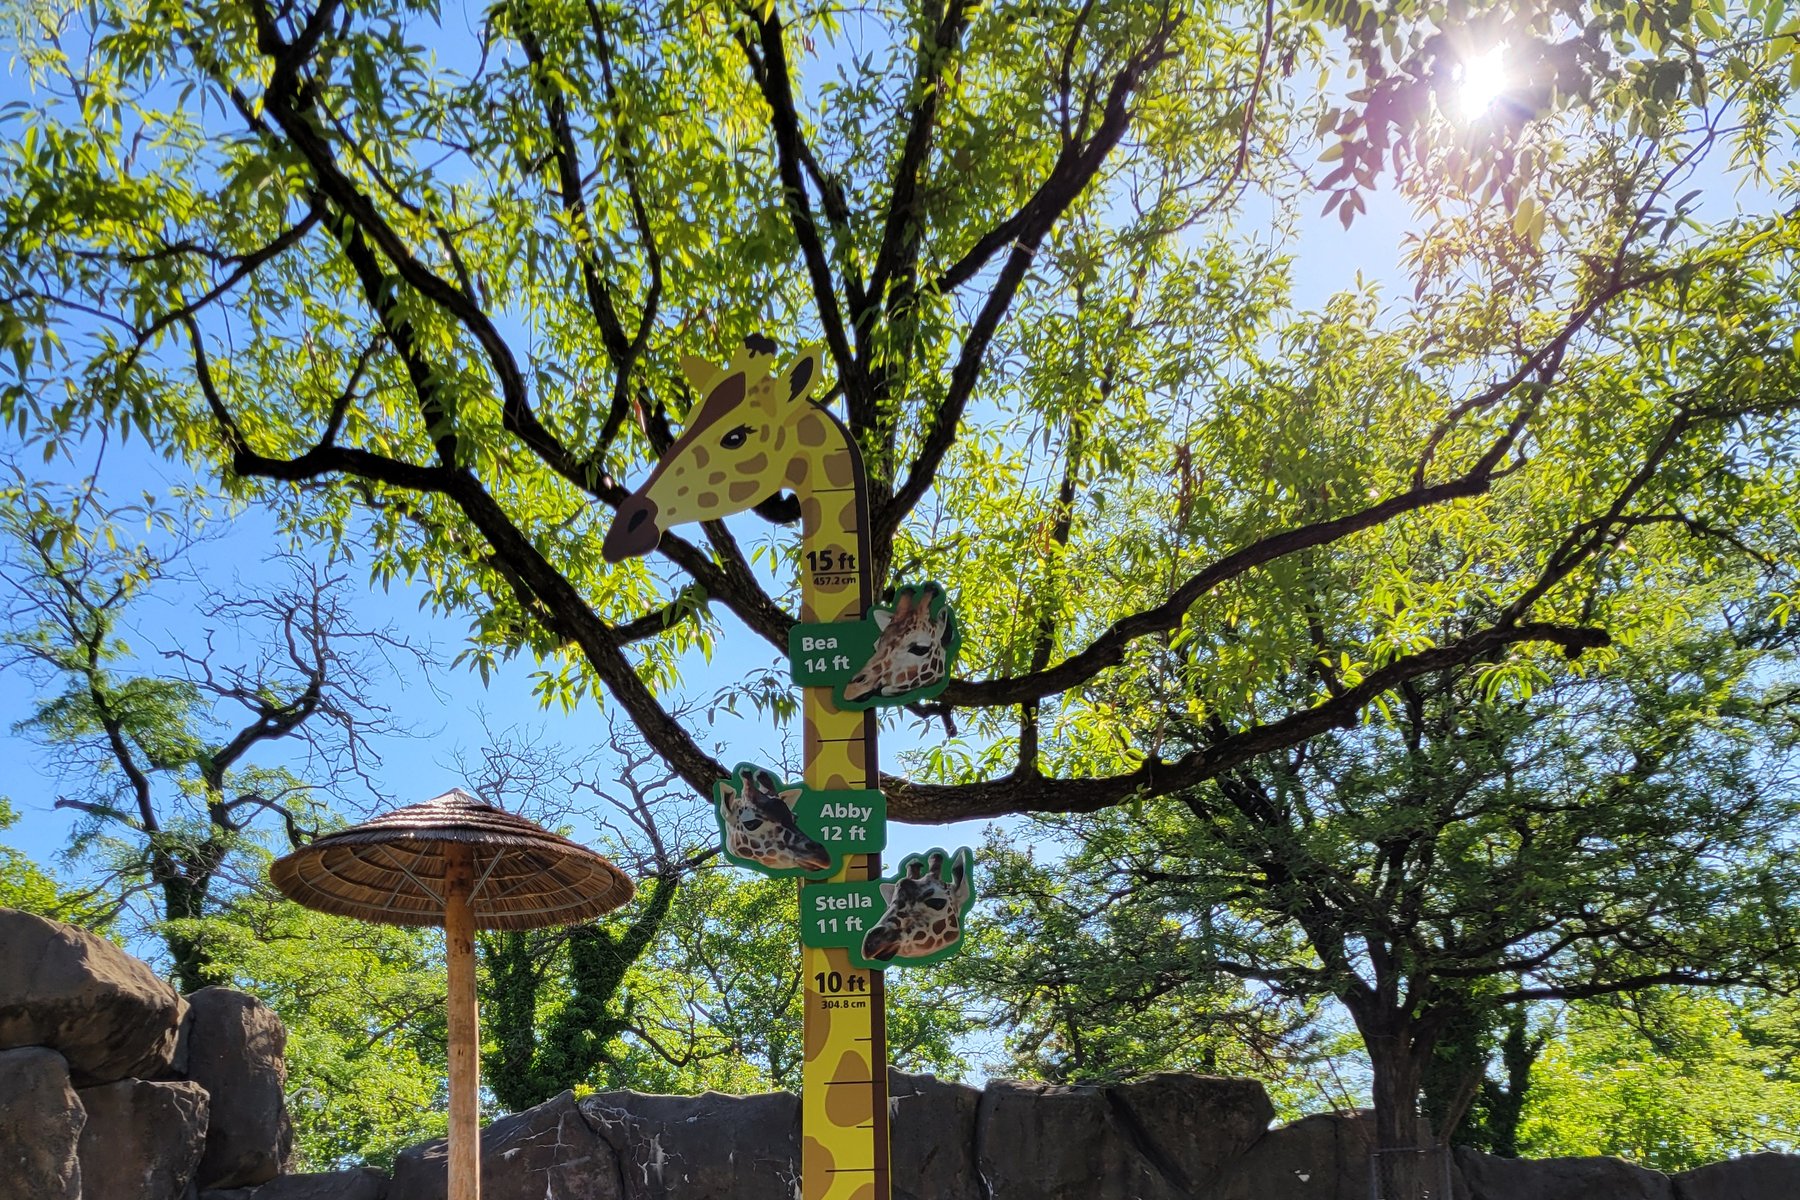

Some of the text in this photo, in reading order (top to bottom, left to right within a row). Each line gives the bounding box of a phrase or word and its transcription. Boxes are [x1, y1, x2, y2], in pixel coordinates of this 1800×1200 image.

[806, 550, 856, 571] 15 ft
[813, 576, 840, 586] 457.2
[802, 636, 838, 652] Bea
[804, 655, 850, 673] 14 ft
[820, 803, 873, 822] Abby
[820, 825, 867, 841] 12 ft
[815, 893, 872, 911] Stella
[816, 916, 863, 934] 11 ft
[814, 971, 866, 993] 10 ft
[821, 1000, 849, 1009] 304.8
